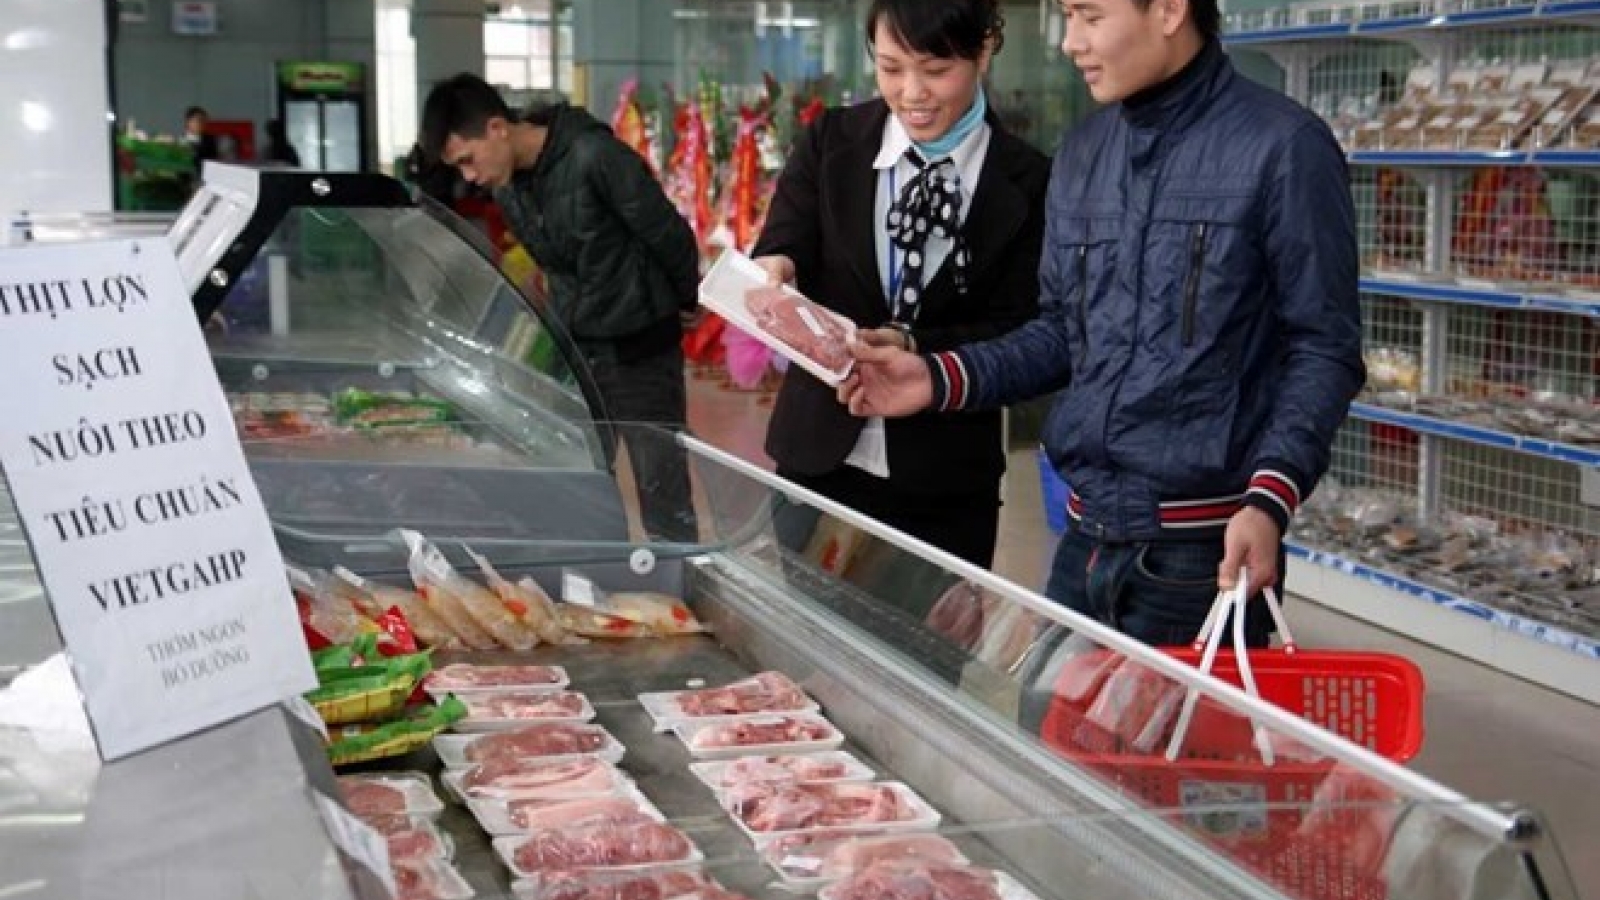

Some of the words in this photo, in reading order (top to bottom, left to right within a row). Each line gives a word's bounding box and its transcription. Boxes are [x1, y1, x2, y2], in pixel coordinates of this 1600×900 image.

[0, 281, 72, 319] THỊT
[81, 273, 148, 312] LỢN
[52, 346, 142, 390] SẠCH
[28, 415, 116, 465] NUÔI
[119, 410, 207, 449] THEO
[43, 495, 127, 542] TIÊU
[88, 549, 246, 611] VIETGAHP
